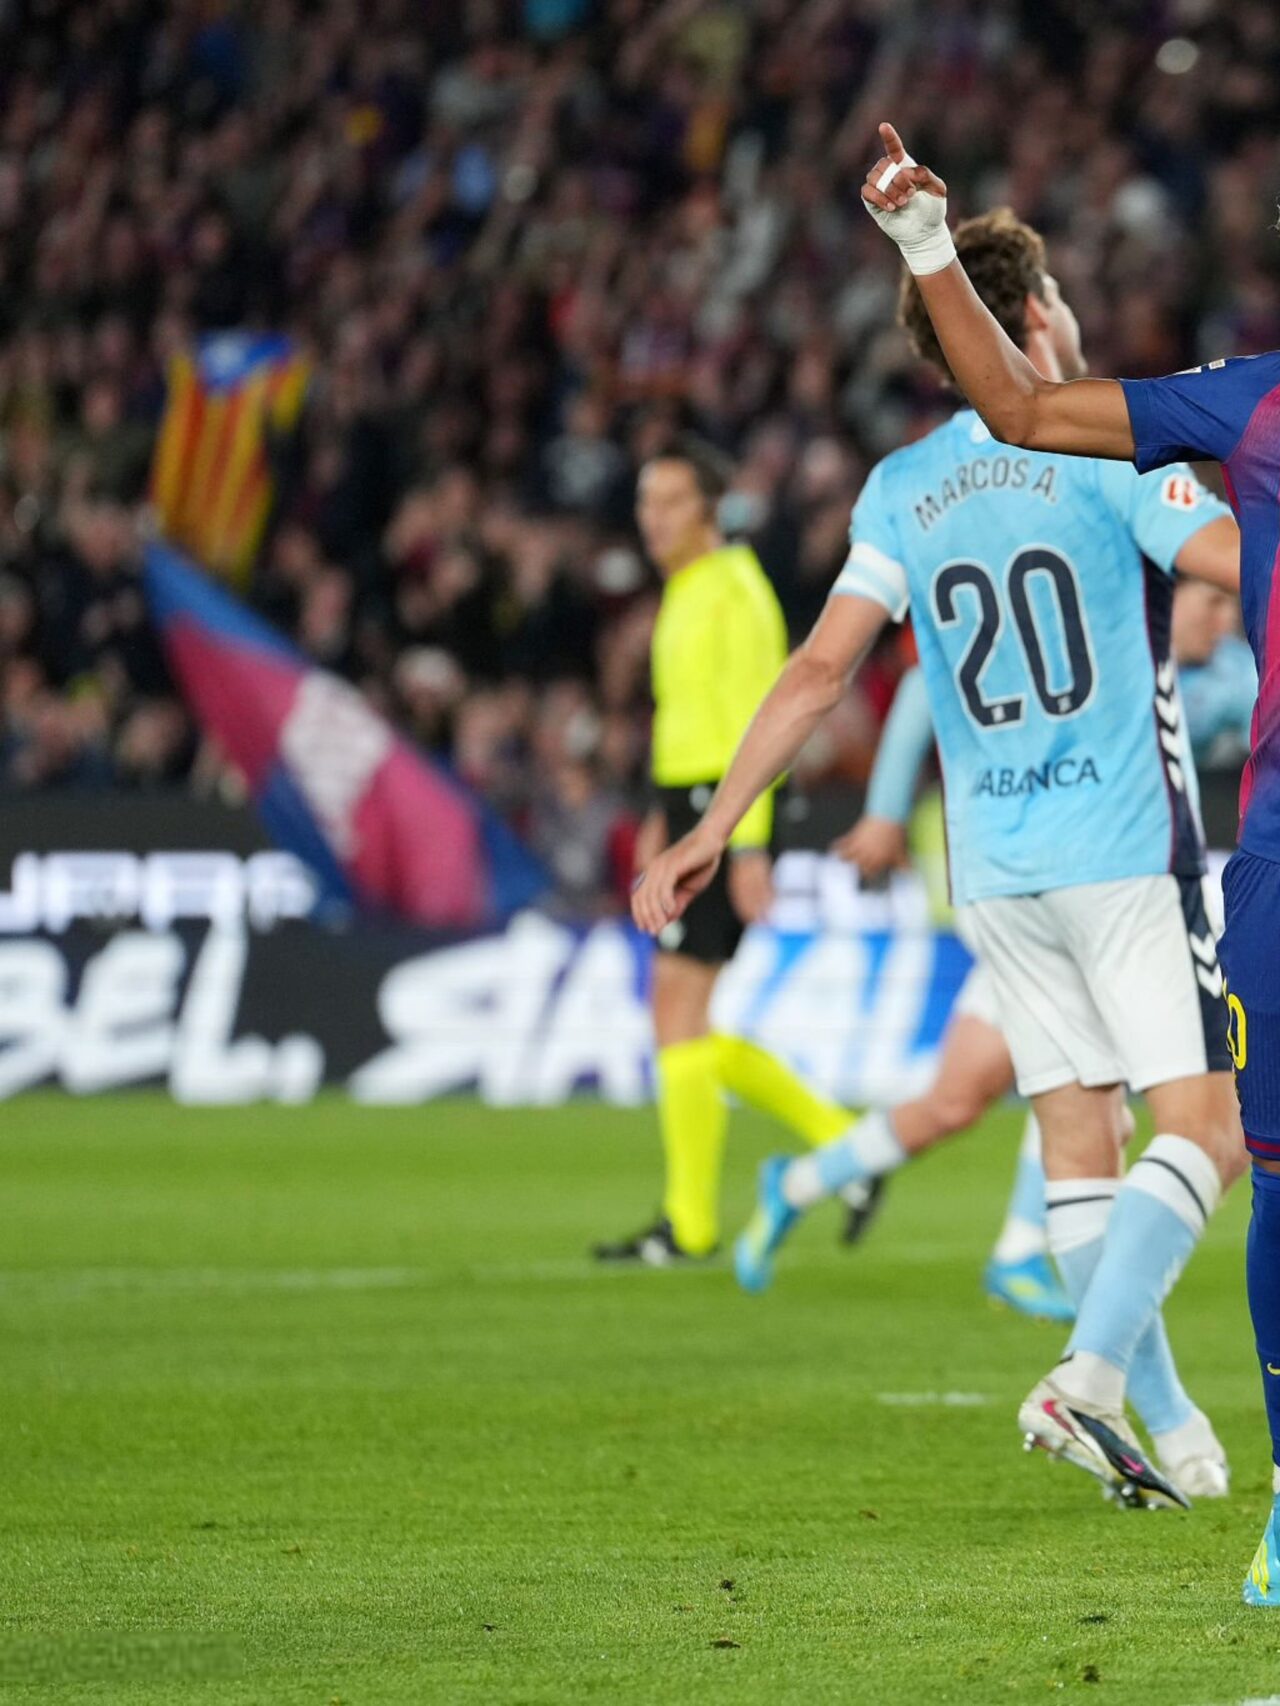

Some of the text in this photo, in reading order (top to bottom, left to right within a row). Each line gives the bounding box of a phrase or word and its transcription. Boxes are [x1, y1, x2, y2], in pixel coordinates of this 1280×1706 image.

[914, 456, 1030, 531] MARCOS
[932, 544, 1096, 730] 20
[972, 756, 1103, 797] ABANCA
